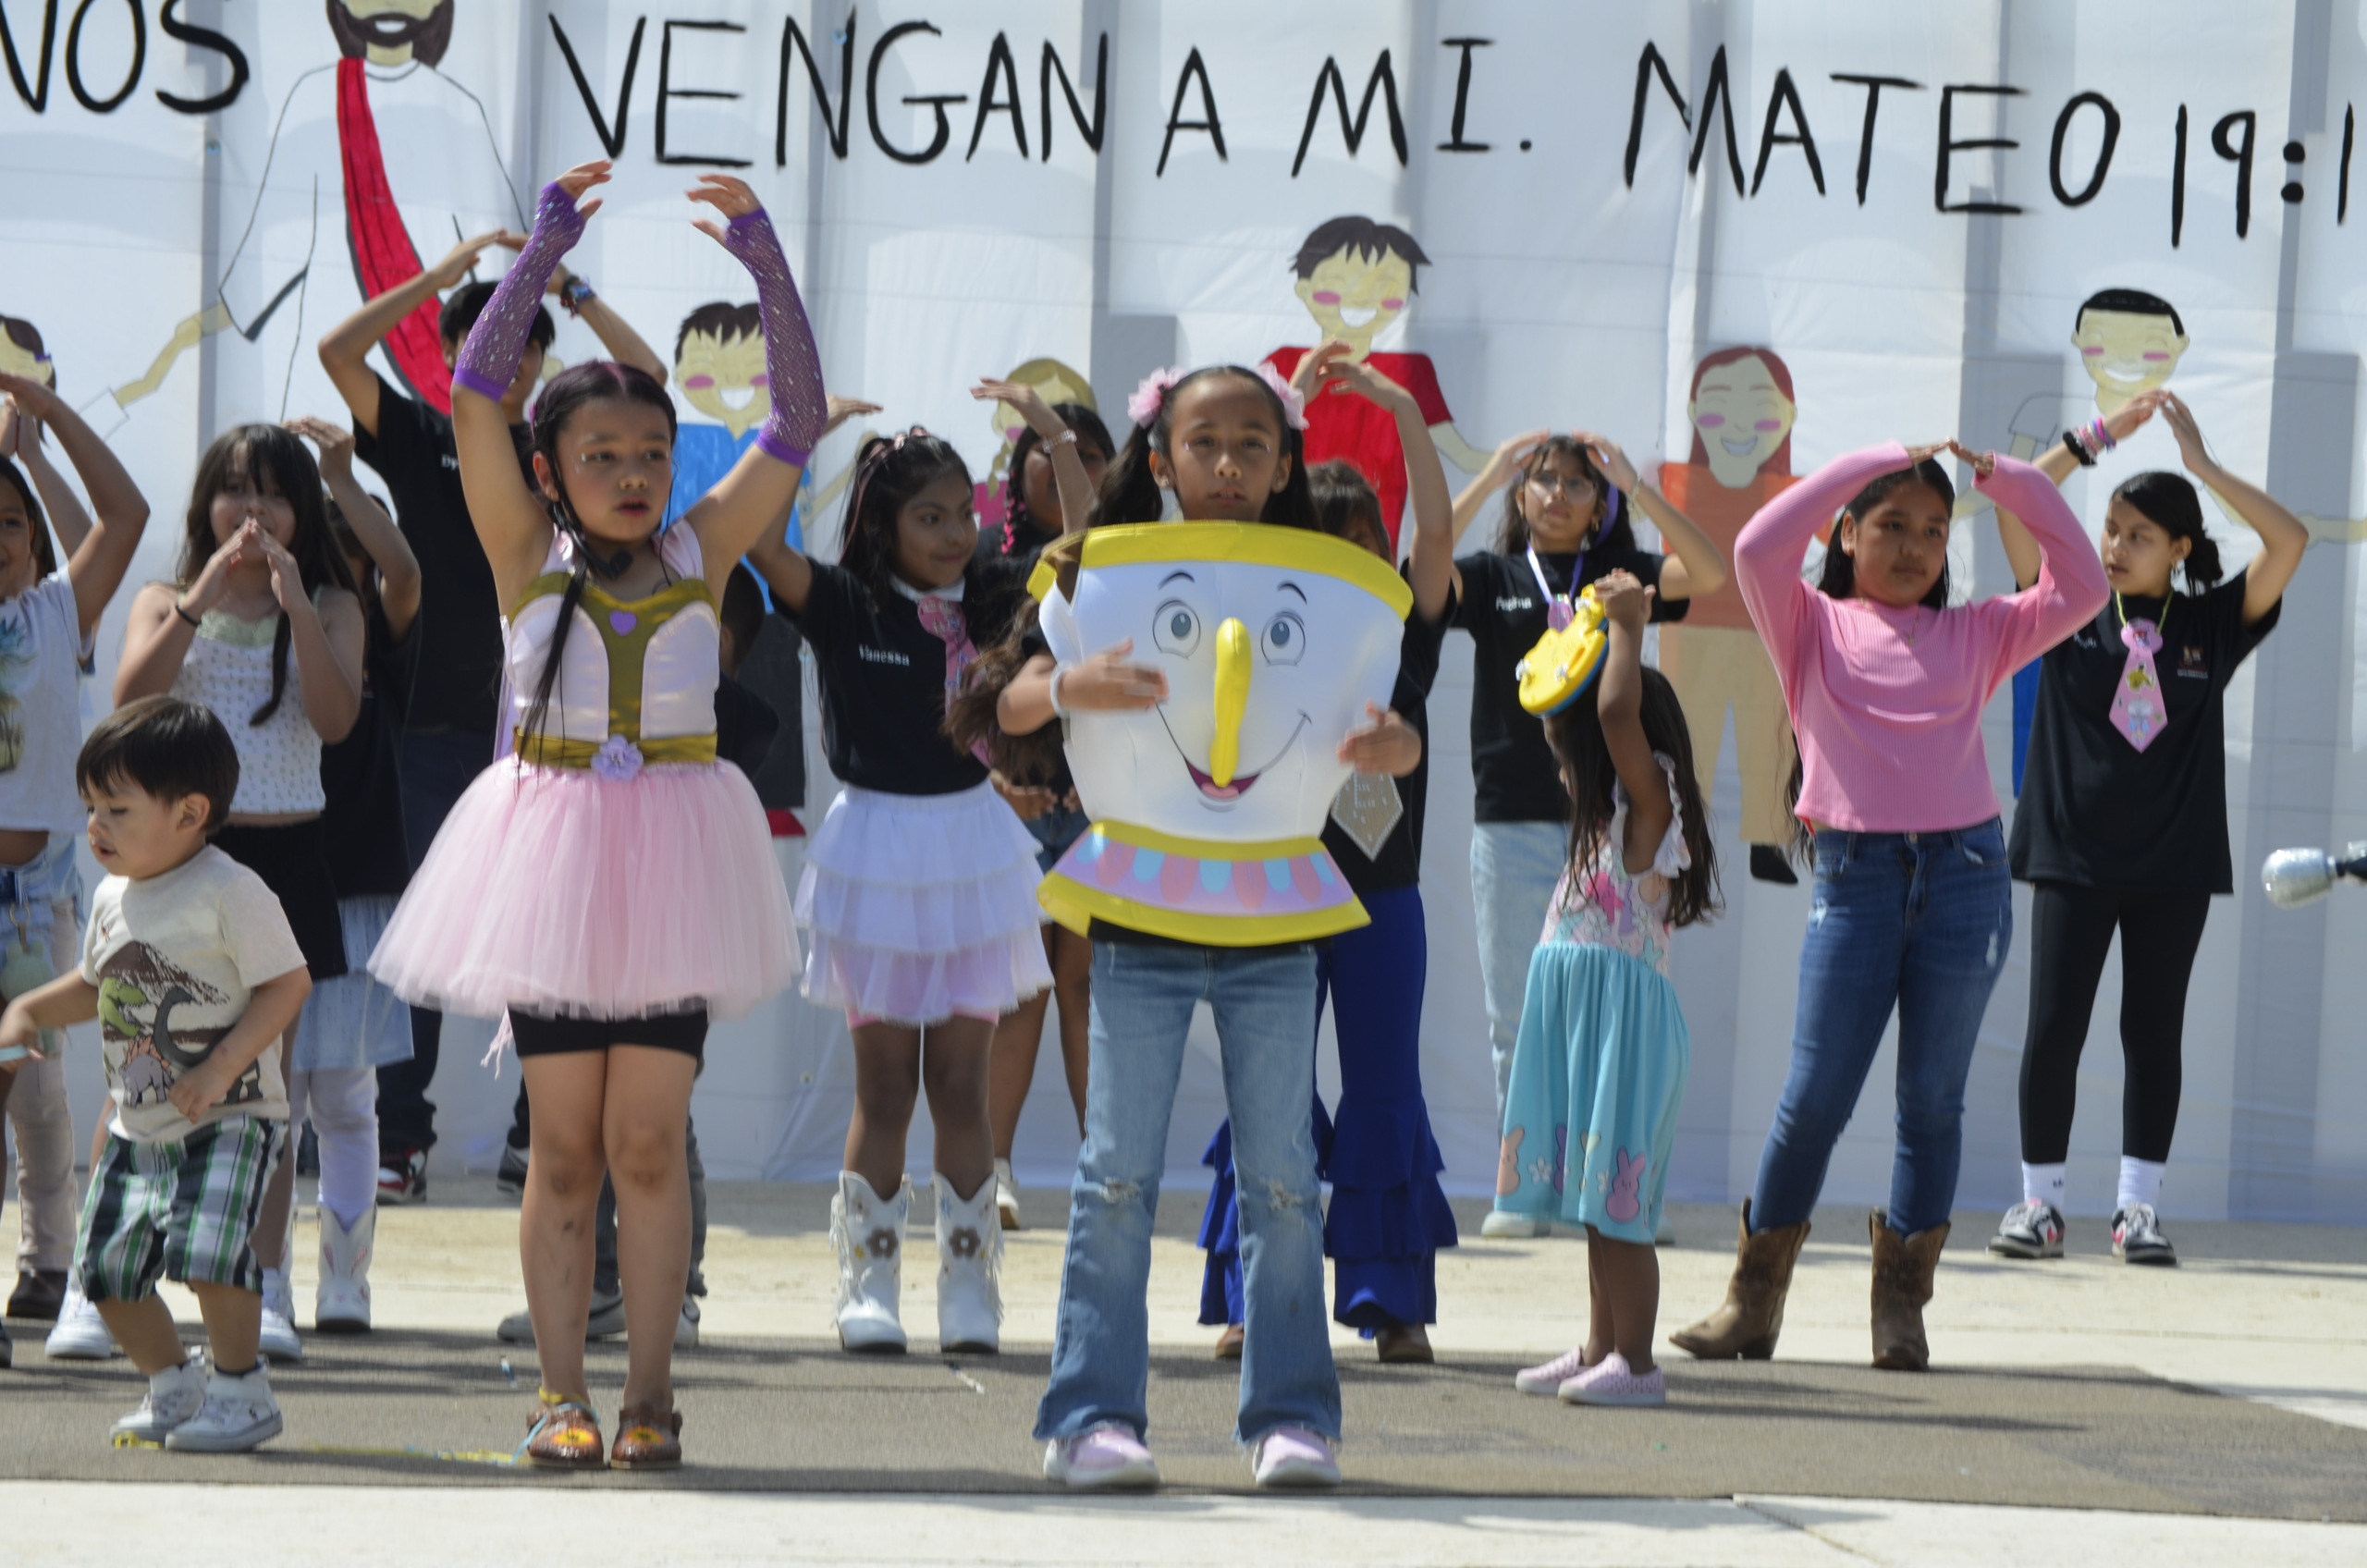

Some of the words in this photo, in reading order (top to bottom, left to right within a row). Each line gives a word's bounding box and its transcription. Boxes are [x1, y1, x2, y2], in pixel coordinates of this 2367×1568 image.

[548, 7, 1108, 168] VENGAN
[1156, 46, 1228, 178] A
[1291, 37, 1534, 178] MI.
[1623, 41, 2123, 215] MATEO
[858, 643, 910, 667] Vanessa
